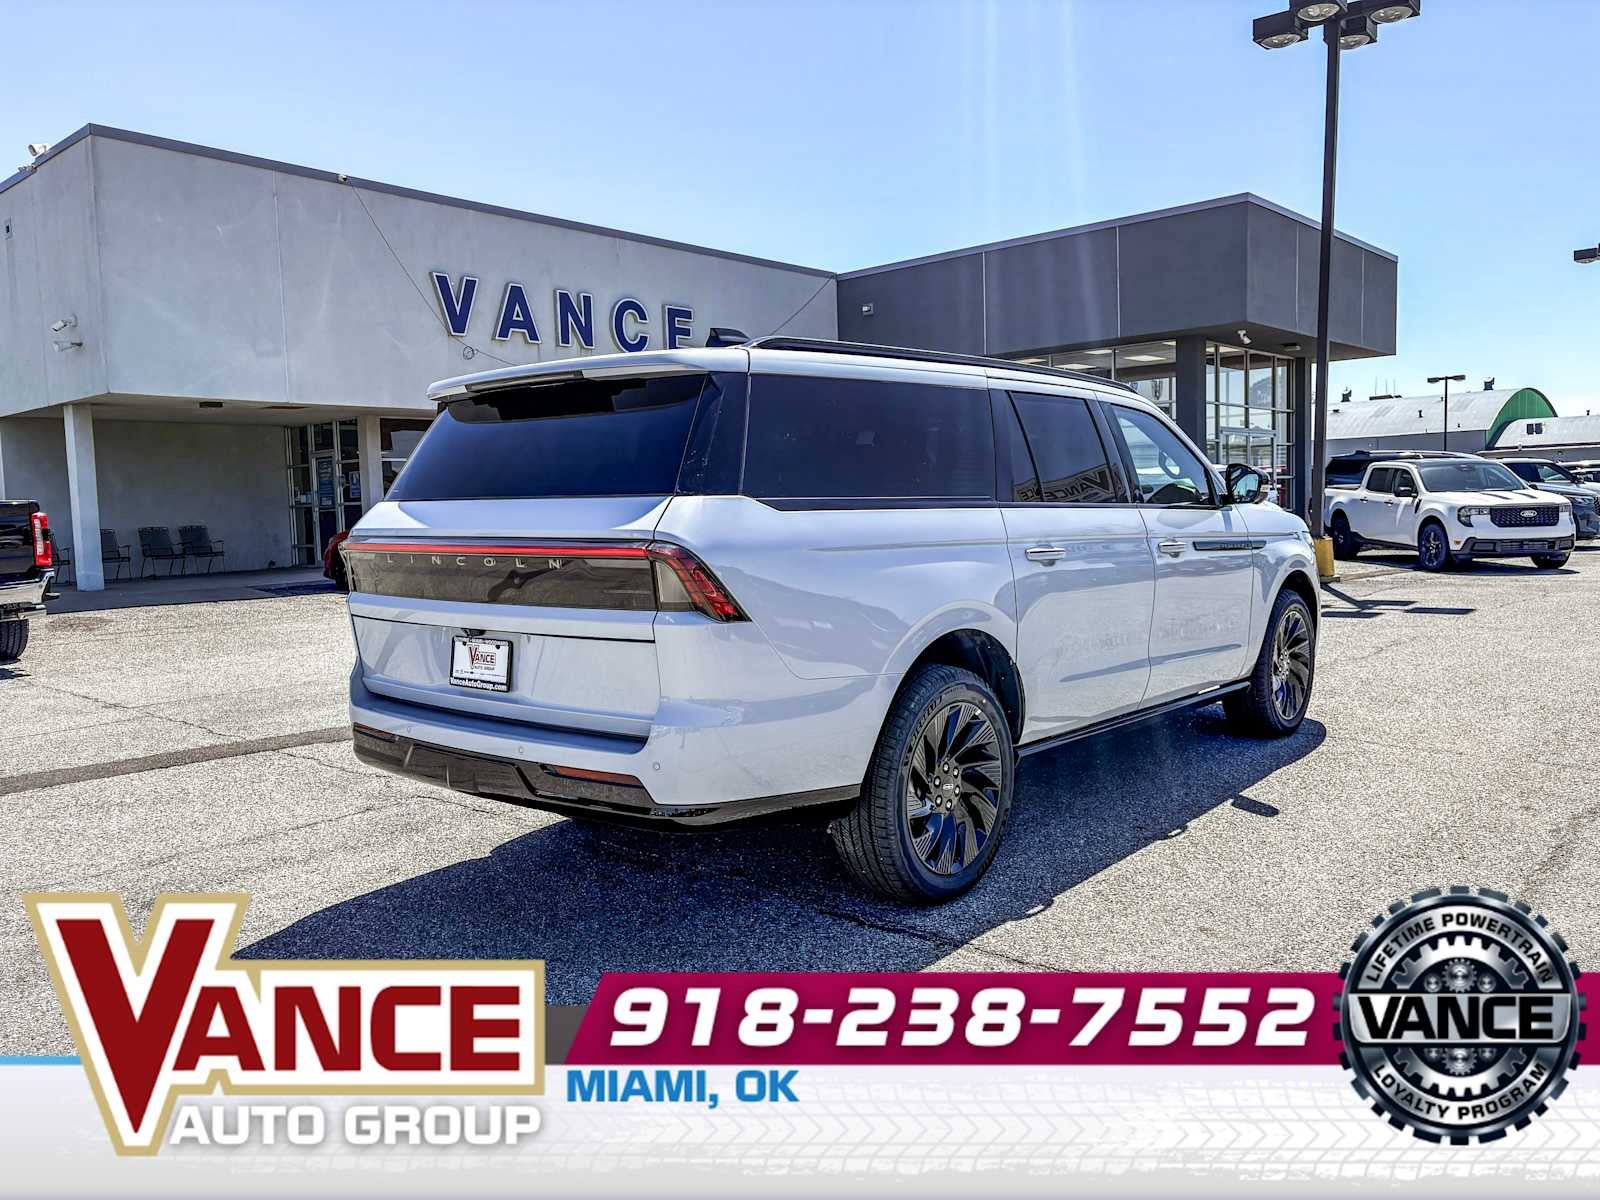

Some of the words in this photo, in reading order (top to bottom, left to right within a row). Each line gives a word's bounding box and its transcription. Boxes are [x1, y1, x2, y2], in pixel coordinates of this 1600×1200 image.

[433, 272, 693, 353] VANCE
[387, 554, 562, 569] LINCOLN
[468, 645, 496, 666] VANCE
